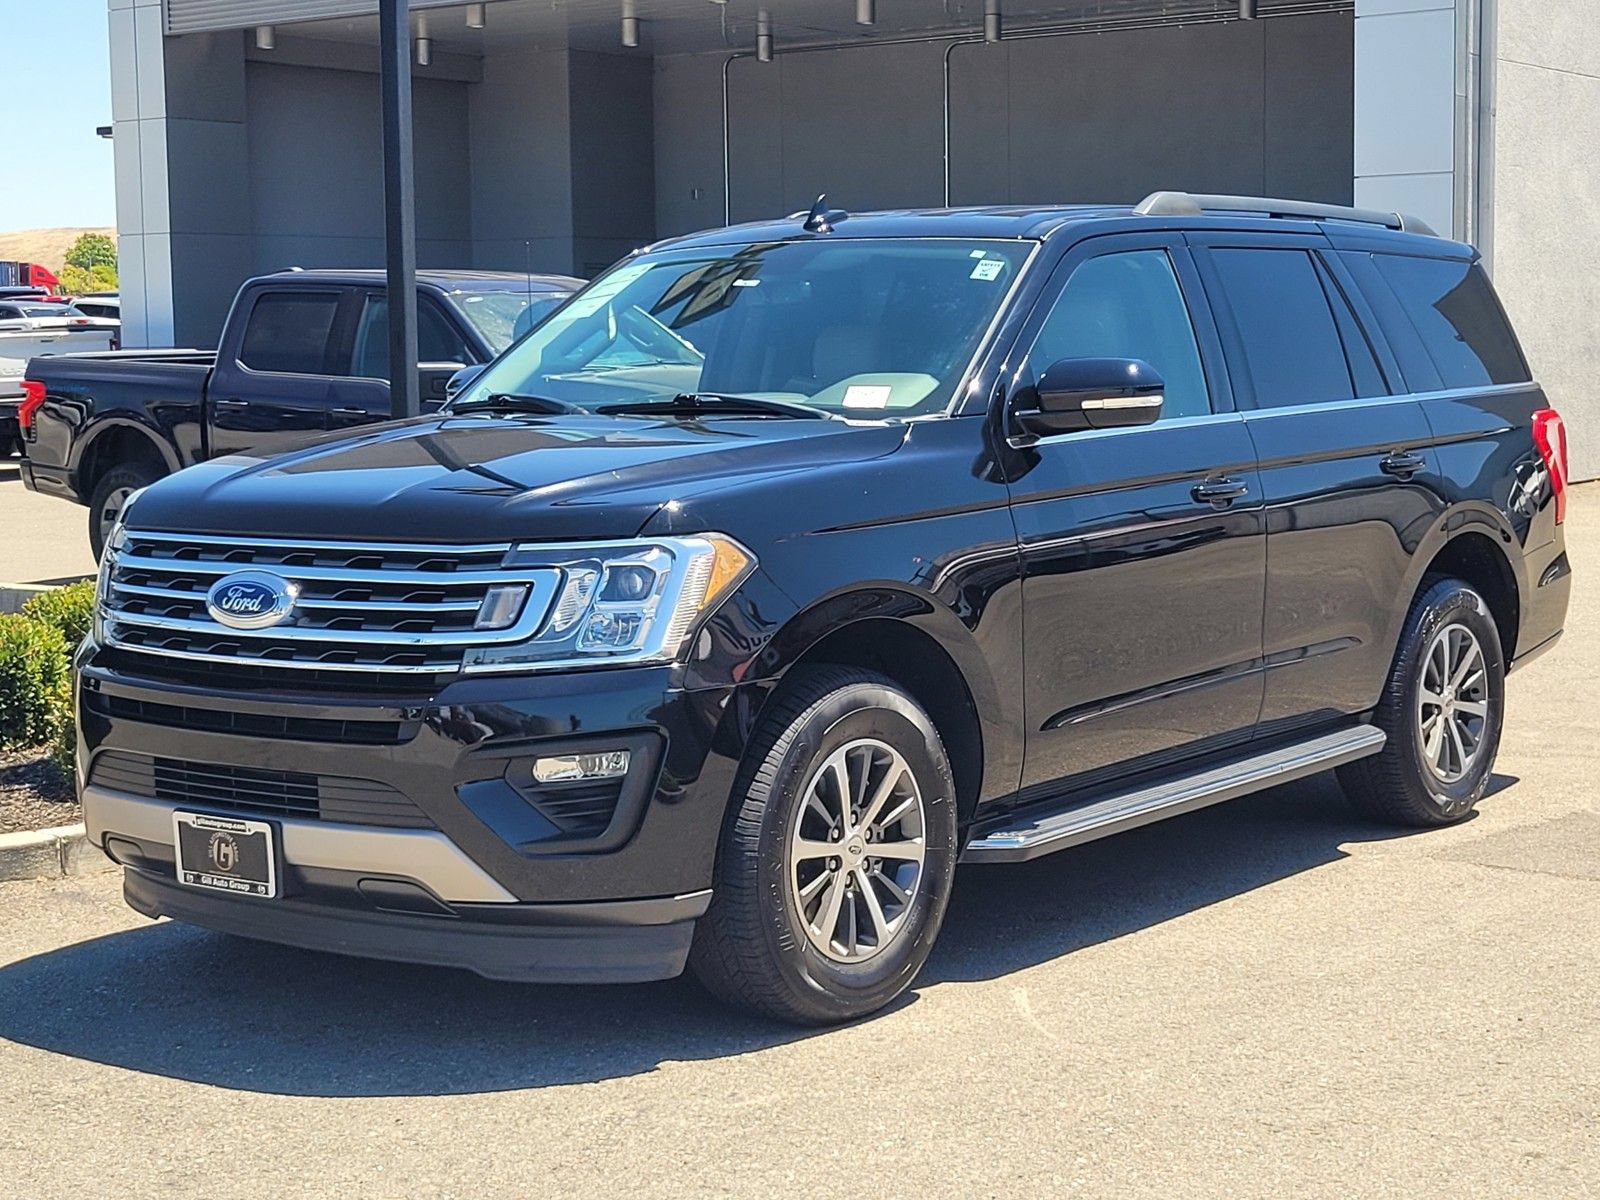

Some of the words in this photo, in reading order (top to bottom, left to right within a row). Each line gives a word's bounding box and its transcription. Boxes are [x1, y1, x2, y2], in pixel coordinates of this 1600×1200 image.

[222, 586, 265, 612] Ford
[213, 878, 228, 887] Auto
[229, 880, 250, 892] Group
